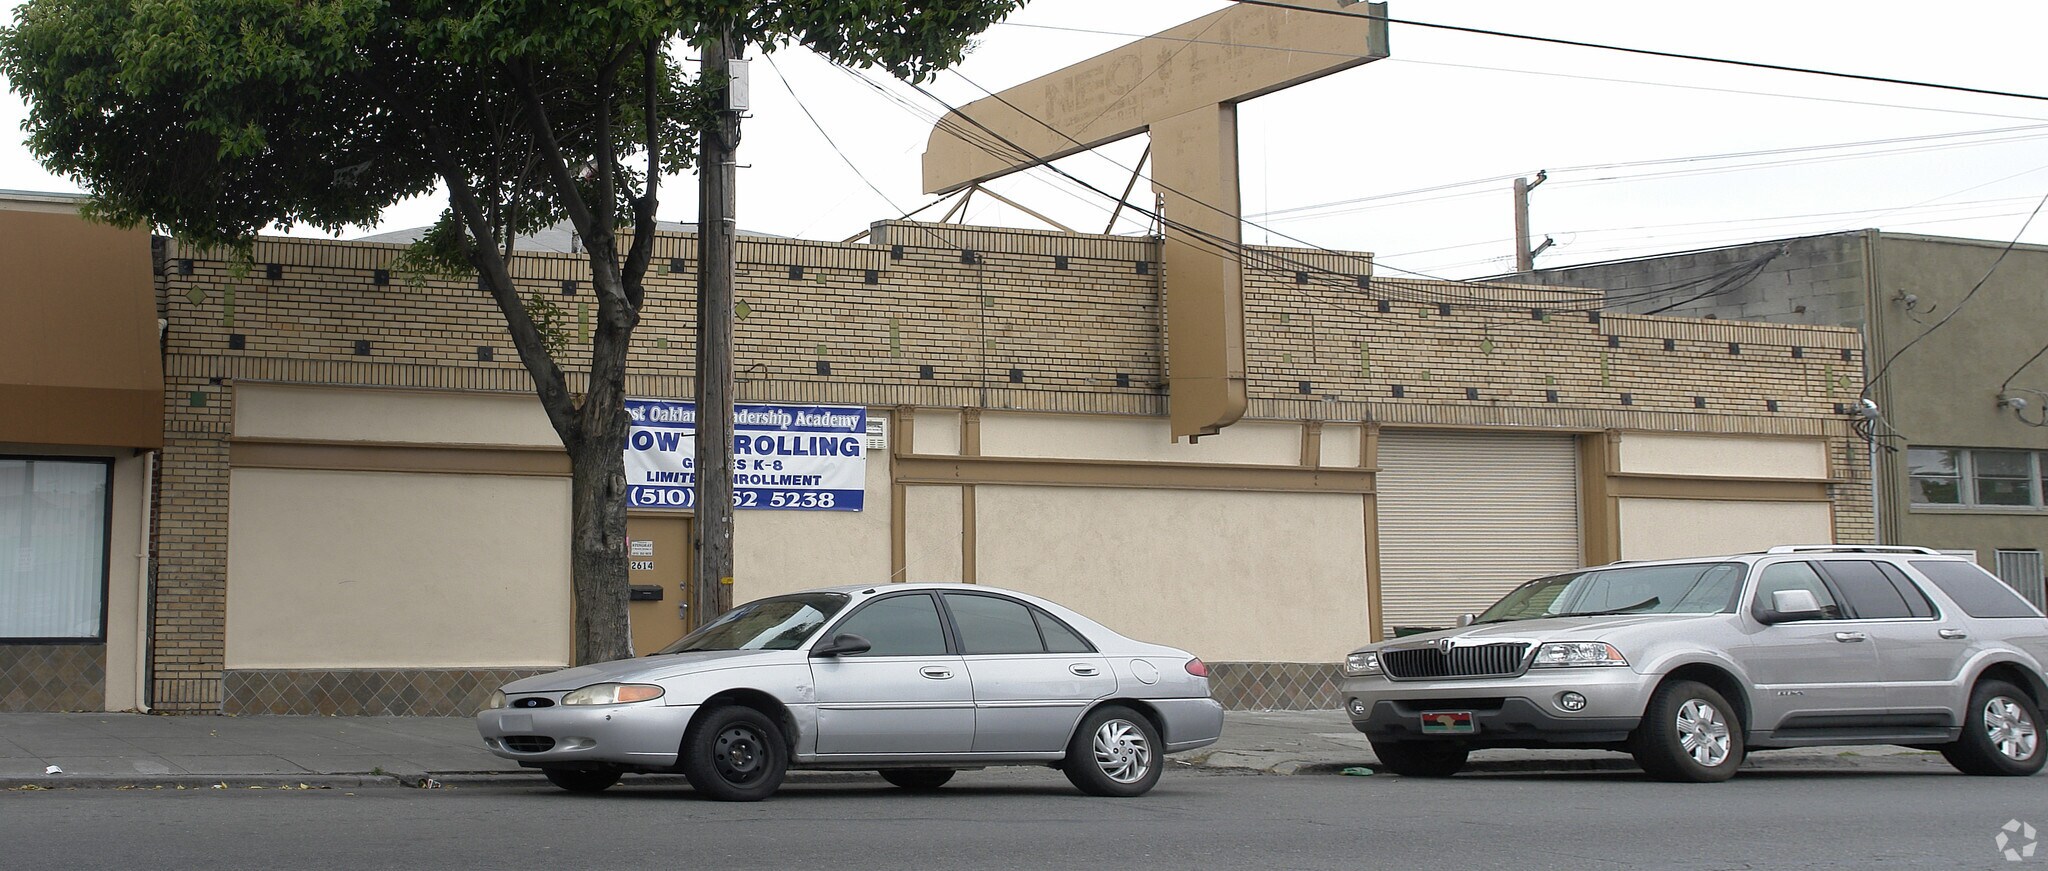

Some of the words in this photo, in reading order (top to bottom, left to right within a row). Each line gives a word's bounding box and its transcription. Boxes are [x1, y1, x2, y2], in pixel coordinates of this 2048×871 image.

[649, 406, 695, 423] Oakla
[734, 409, 792, 430] dership
[795, 411, 860, 432] Academy
[624, 430, 680, 452] OW
[734, 435, 860, 457] ROLLING
[753, 459, 783, 470] K-8
[646, 471, 695, 484] LIMITE
[734, 474, 822, 486] ROLLMENT
[630, 486, 695, 507] (510)
[733, 491, 757, 506] 62
[769, 492, 835, 508] 5238
[631, 561, 653, 570] 2614
